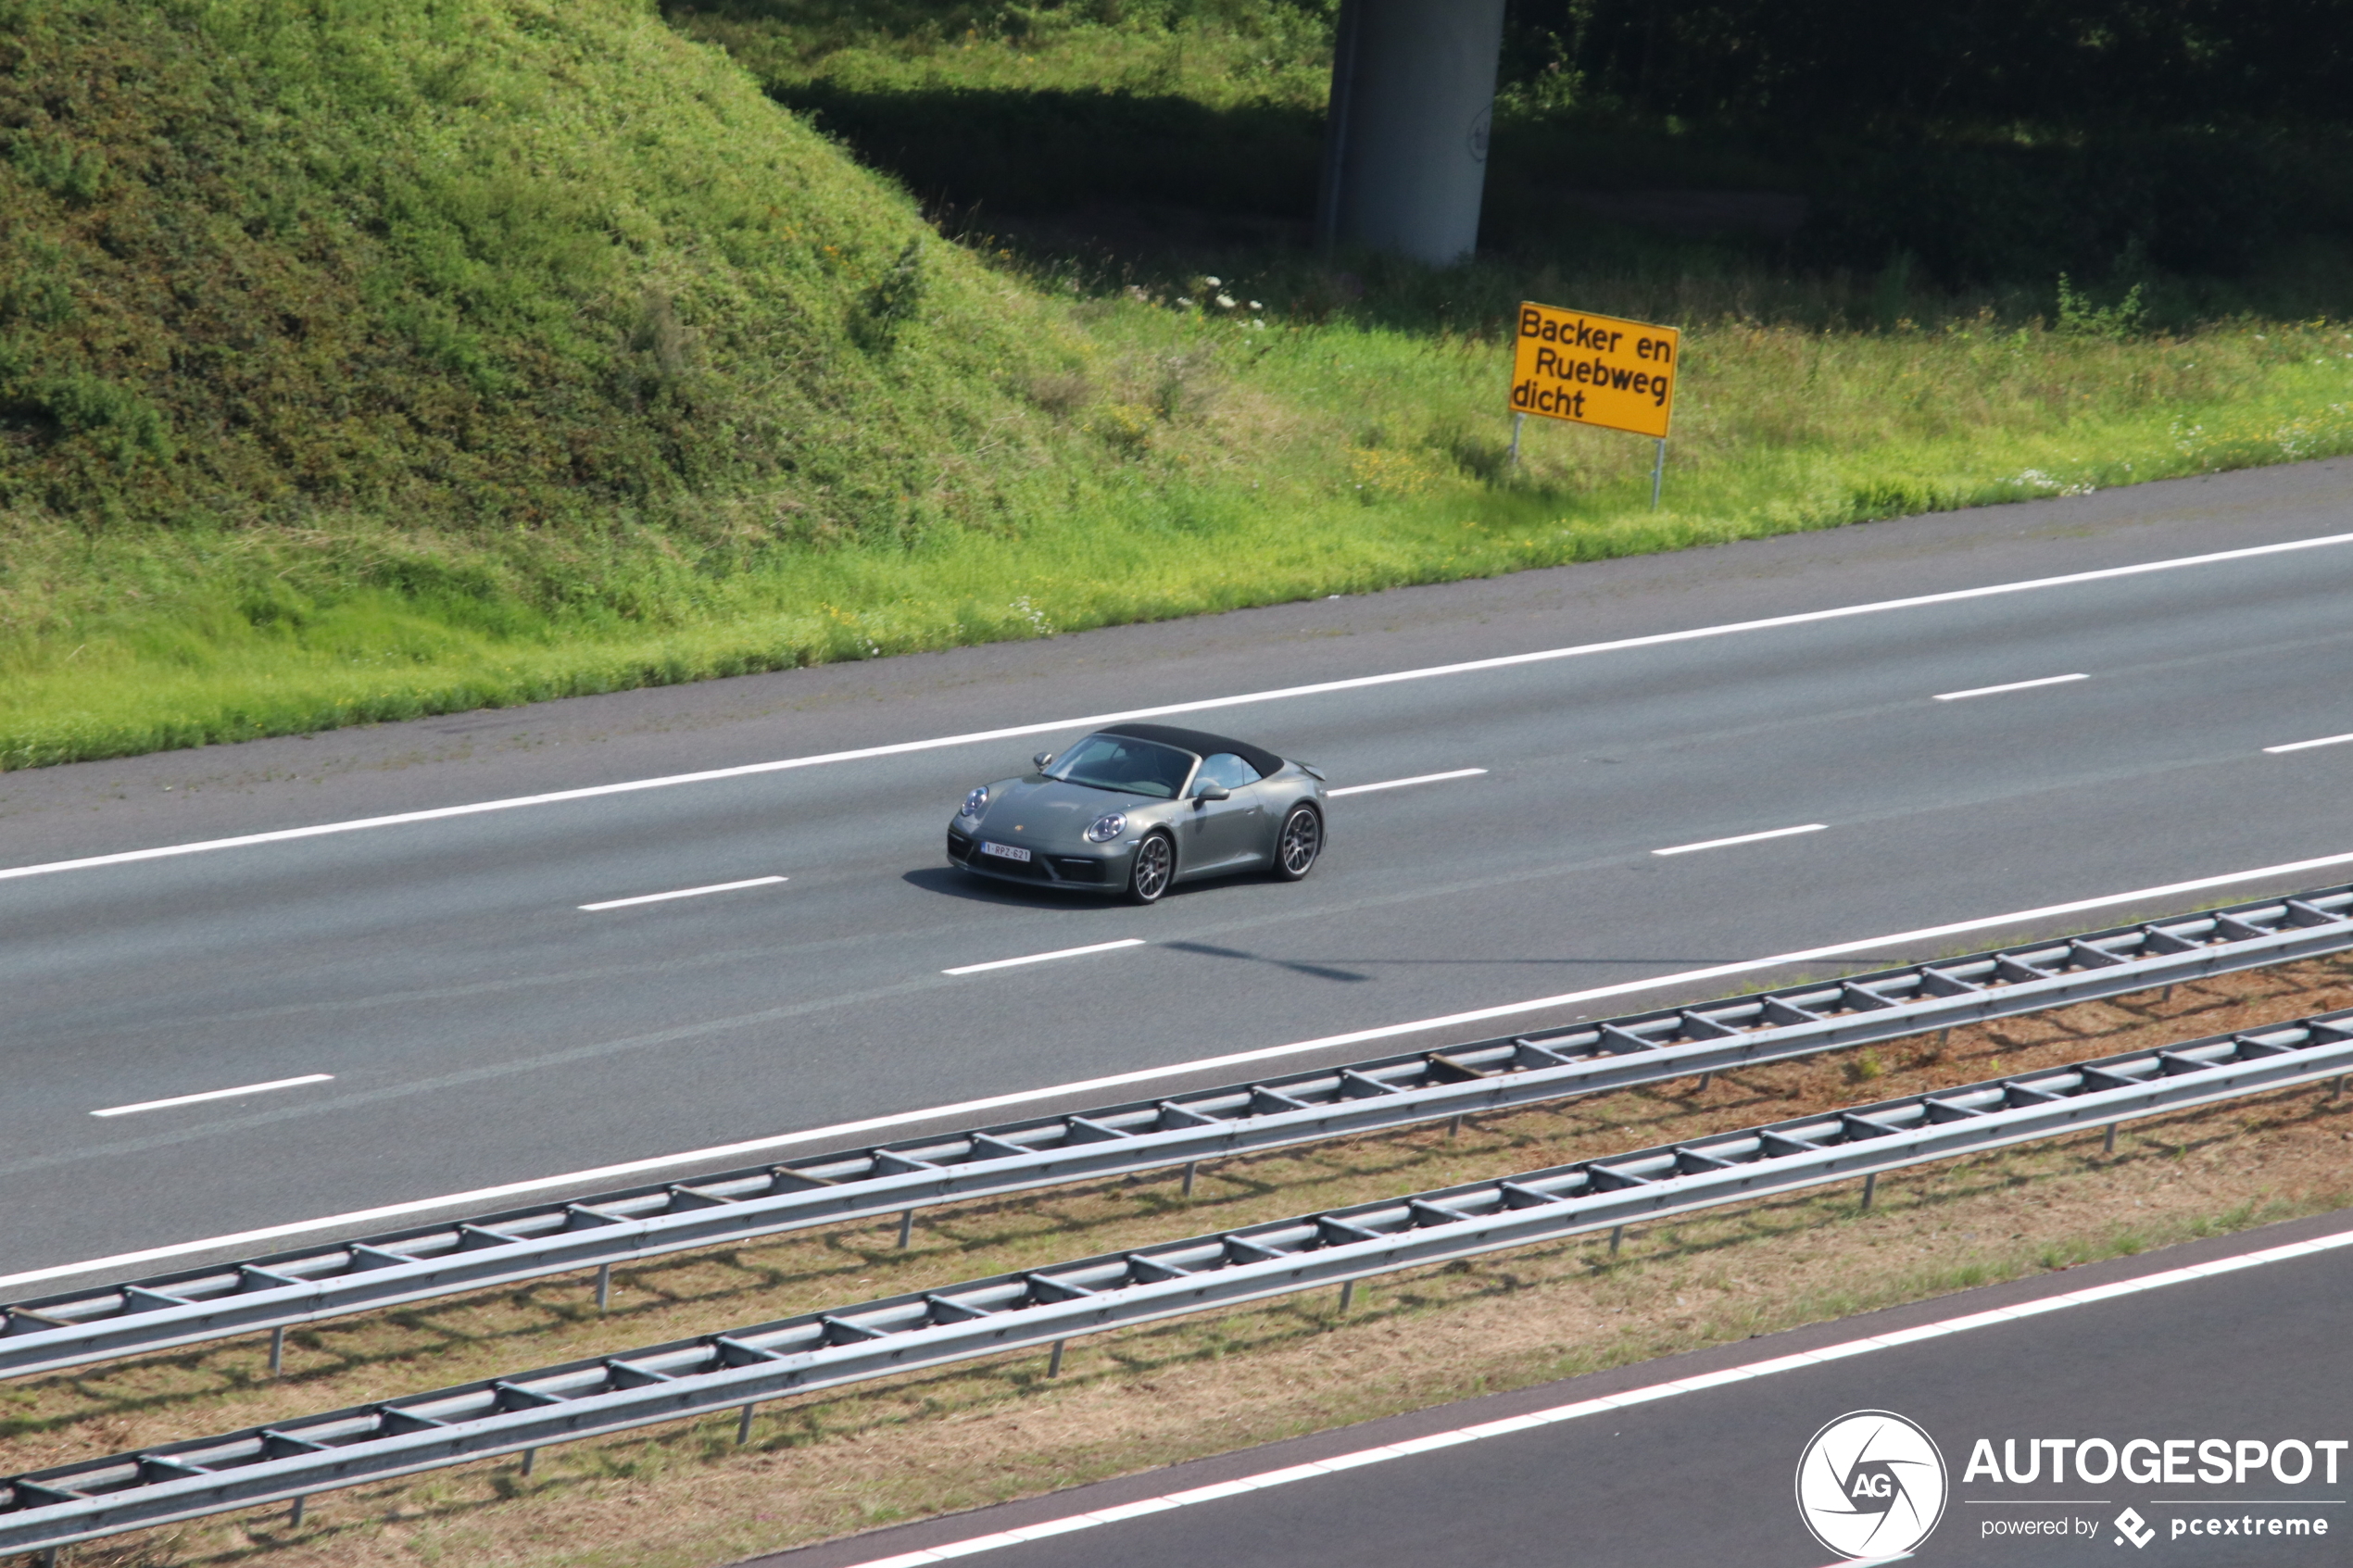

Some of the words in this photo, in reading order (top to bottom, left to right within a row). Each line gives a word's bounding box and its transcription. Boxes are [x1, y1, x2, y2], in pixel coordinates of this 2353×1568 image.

[1520, 308, 1623, 353] Backer
[1637, 337, 1671, 363] en
[1513, 379, 1585, 418] dicht
[1536, 346, 1667, 407] Ruebweg
